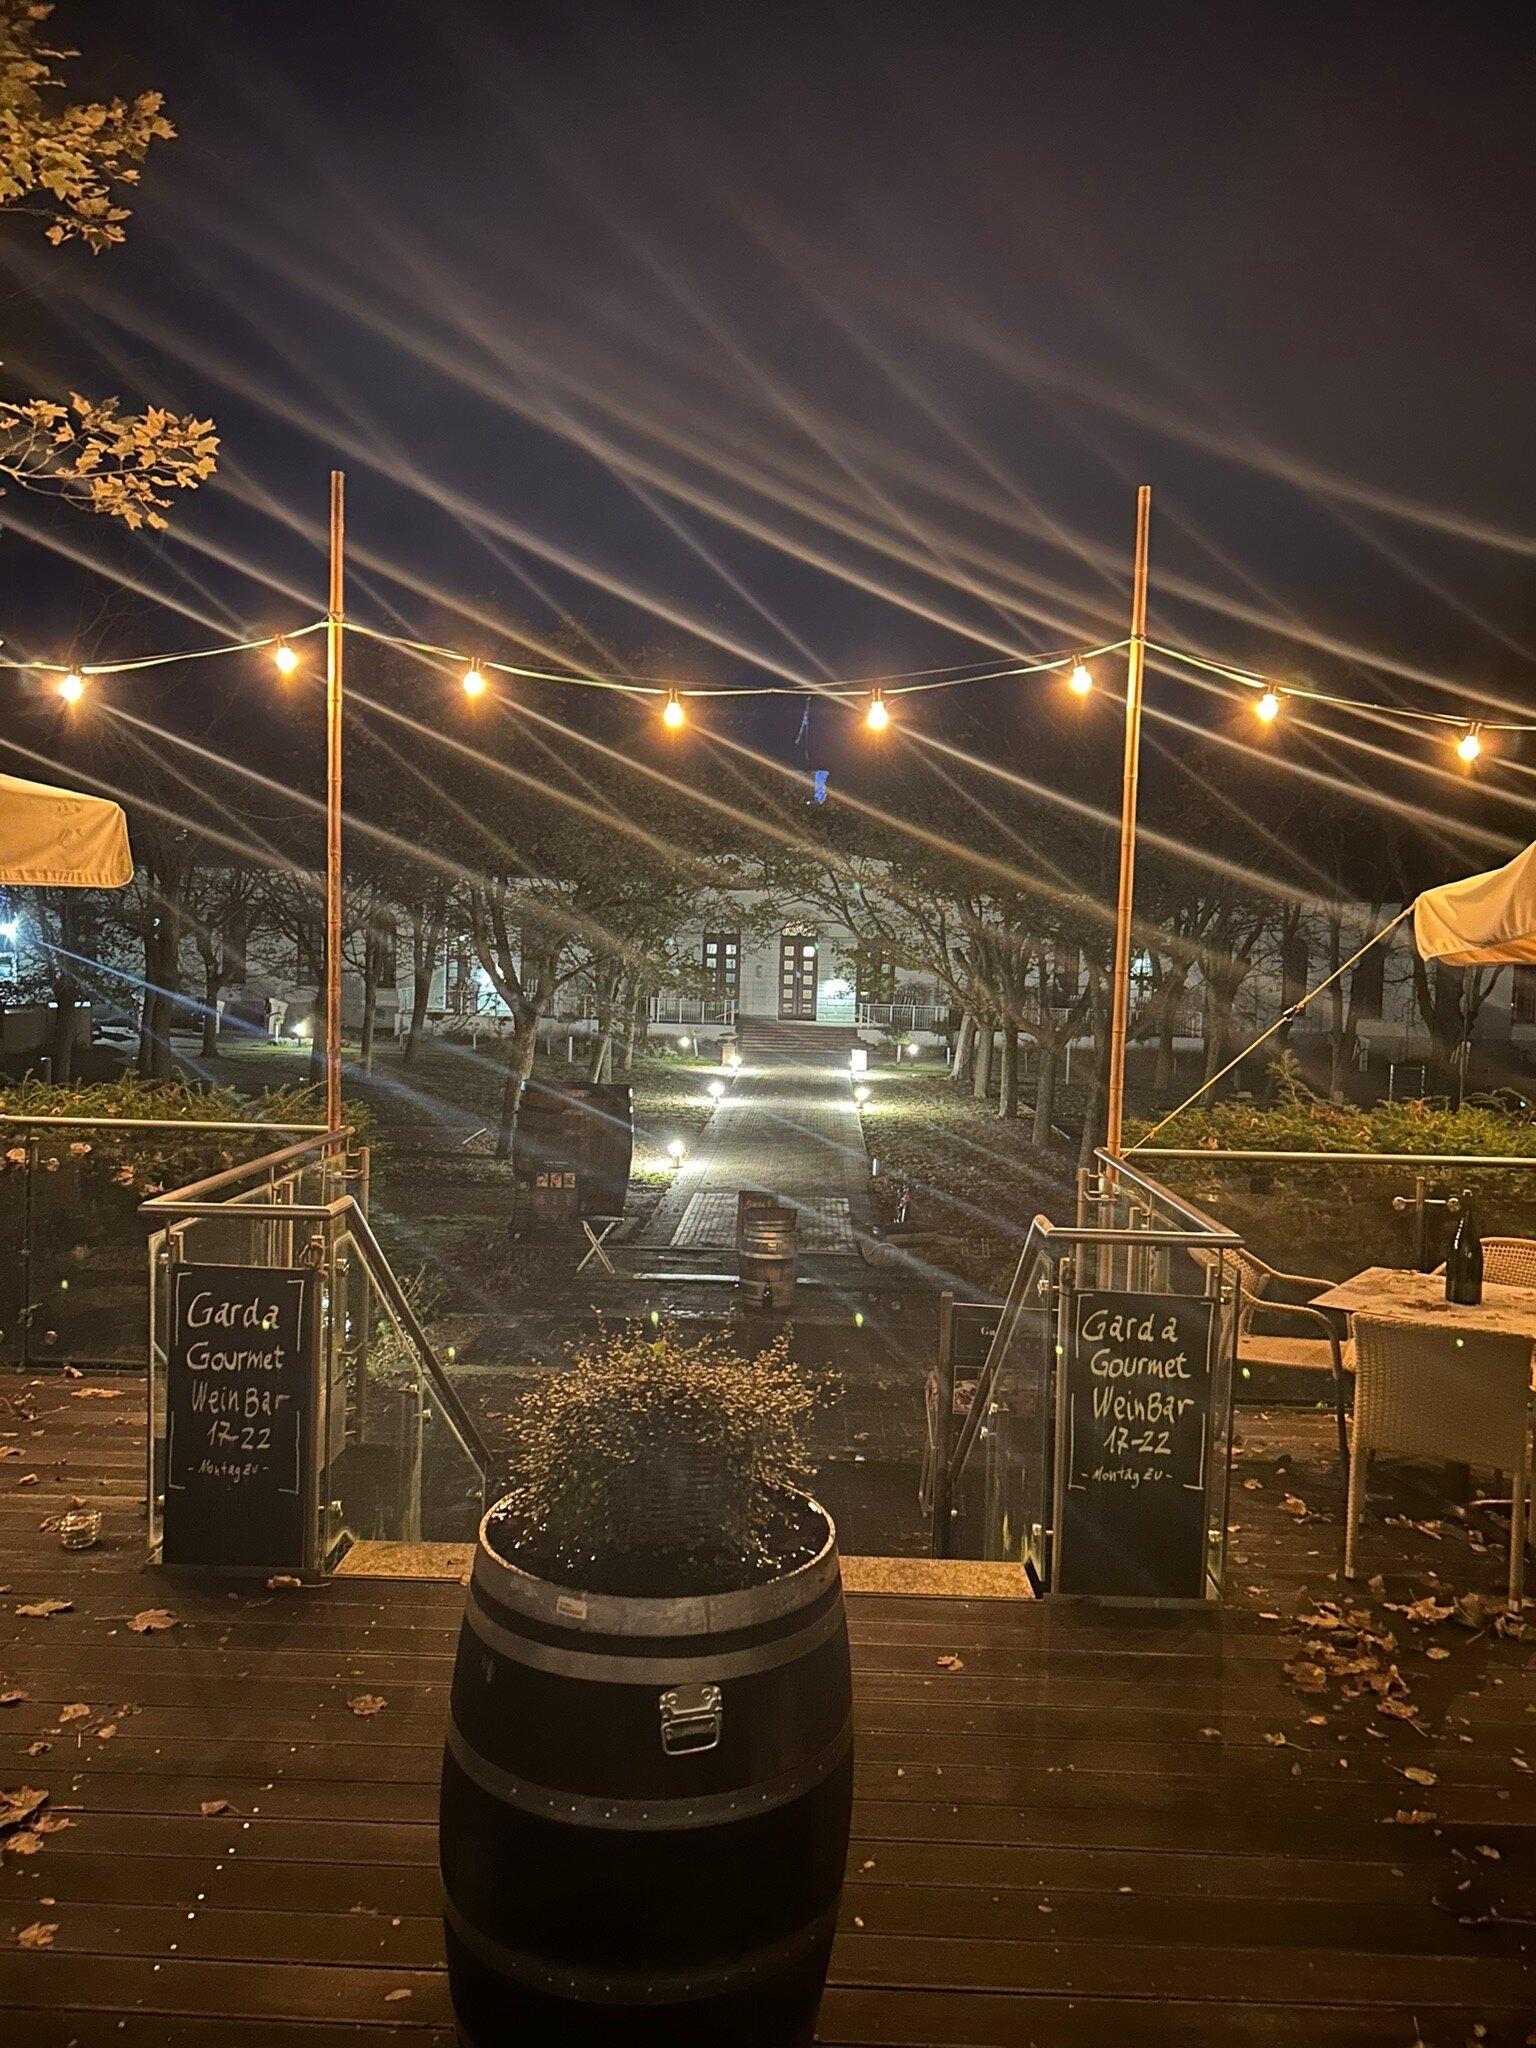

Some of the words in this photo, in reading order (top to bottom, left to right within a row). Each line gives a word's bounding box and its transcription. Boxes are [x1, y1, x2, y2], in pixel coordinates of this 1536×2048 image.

[187, 1291, 280, 1330] Garda
[1081, 1309, 1179, 1343] Garda
[186, 1341, 285, 1371] Gourmet
[1090, 1348, 1192, 1379] Gourmet
[1103, 1425, 1172, 1455] 17-22
[1091, 1465, 1140, 1490] Montag
